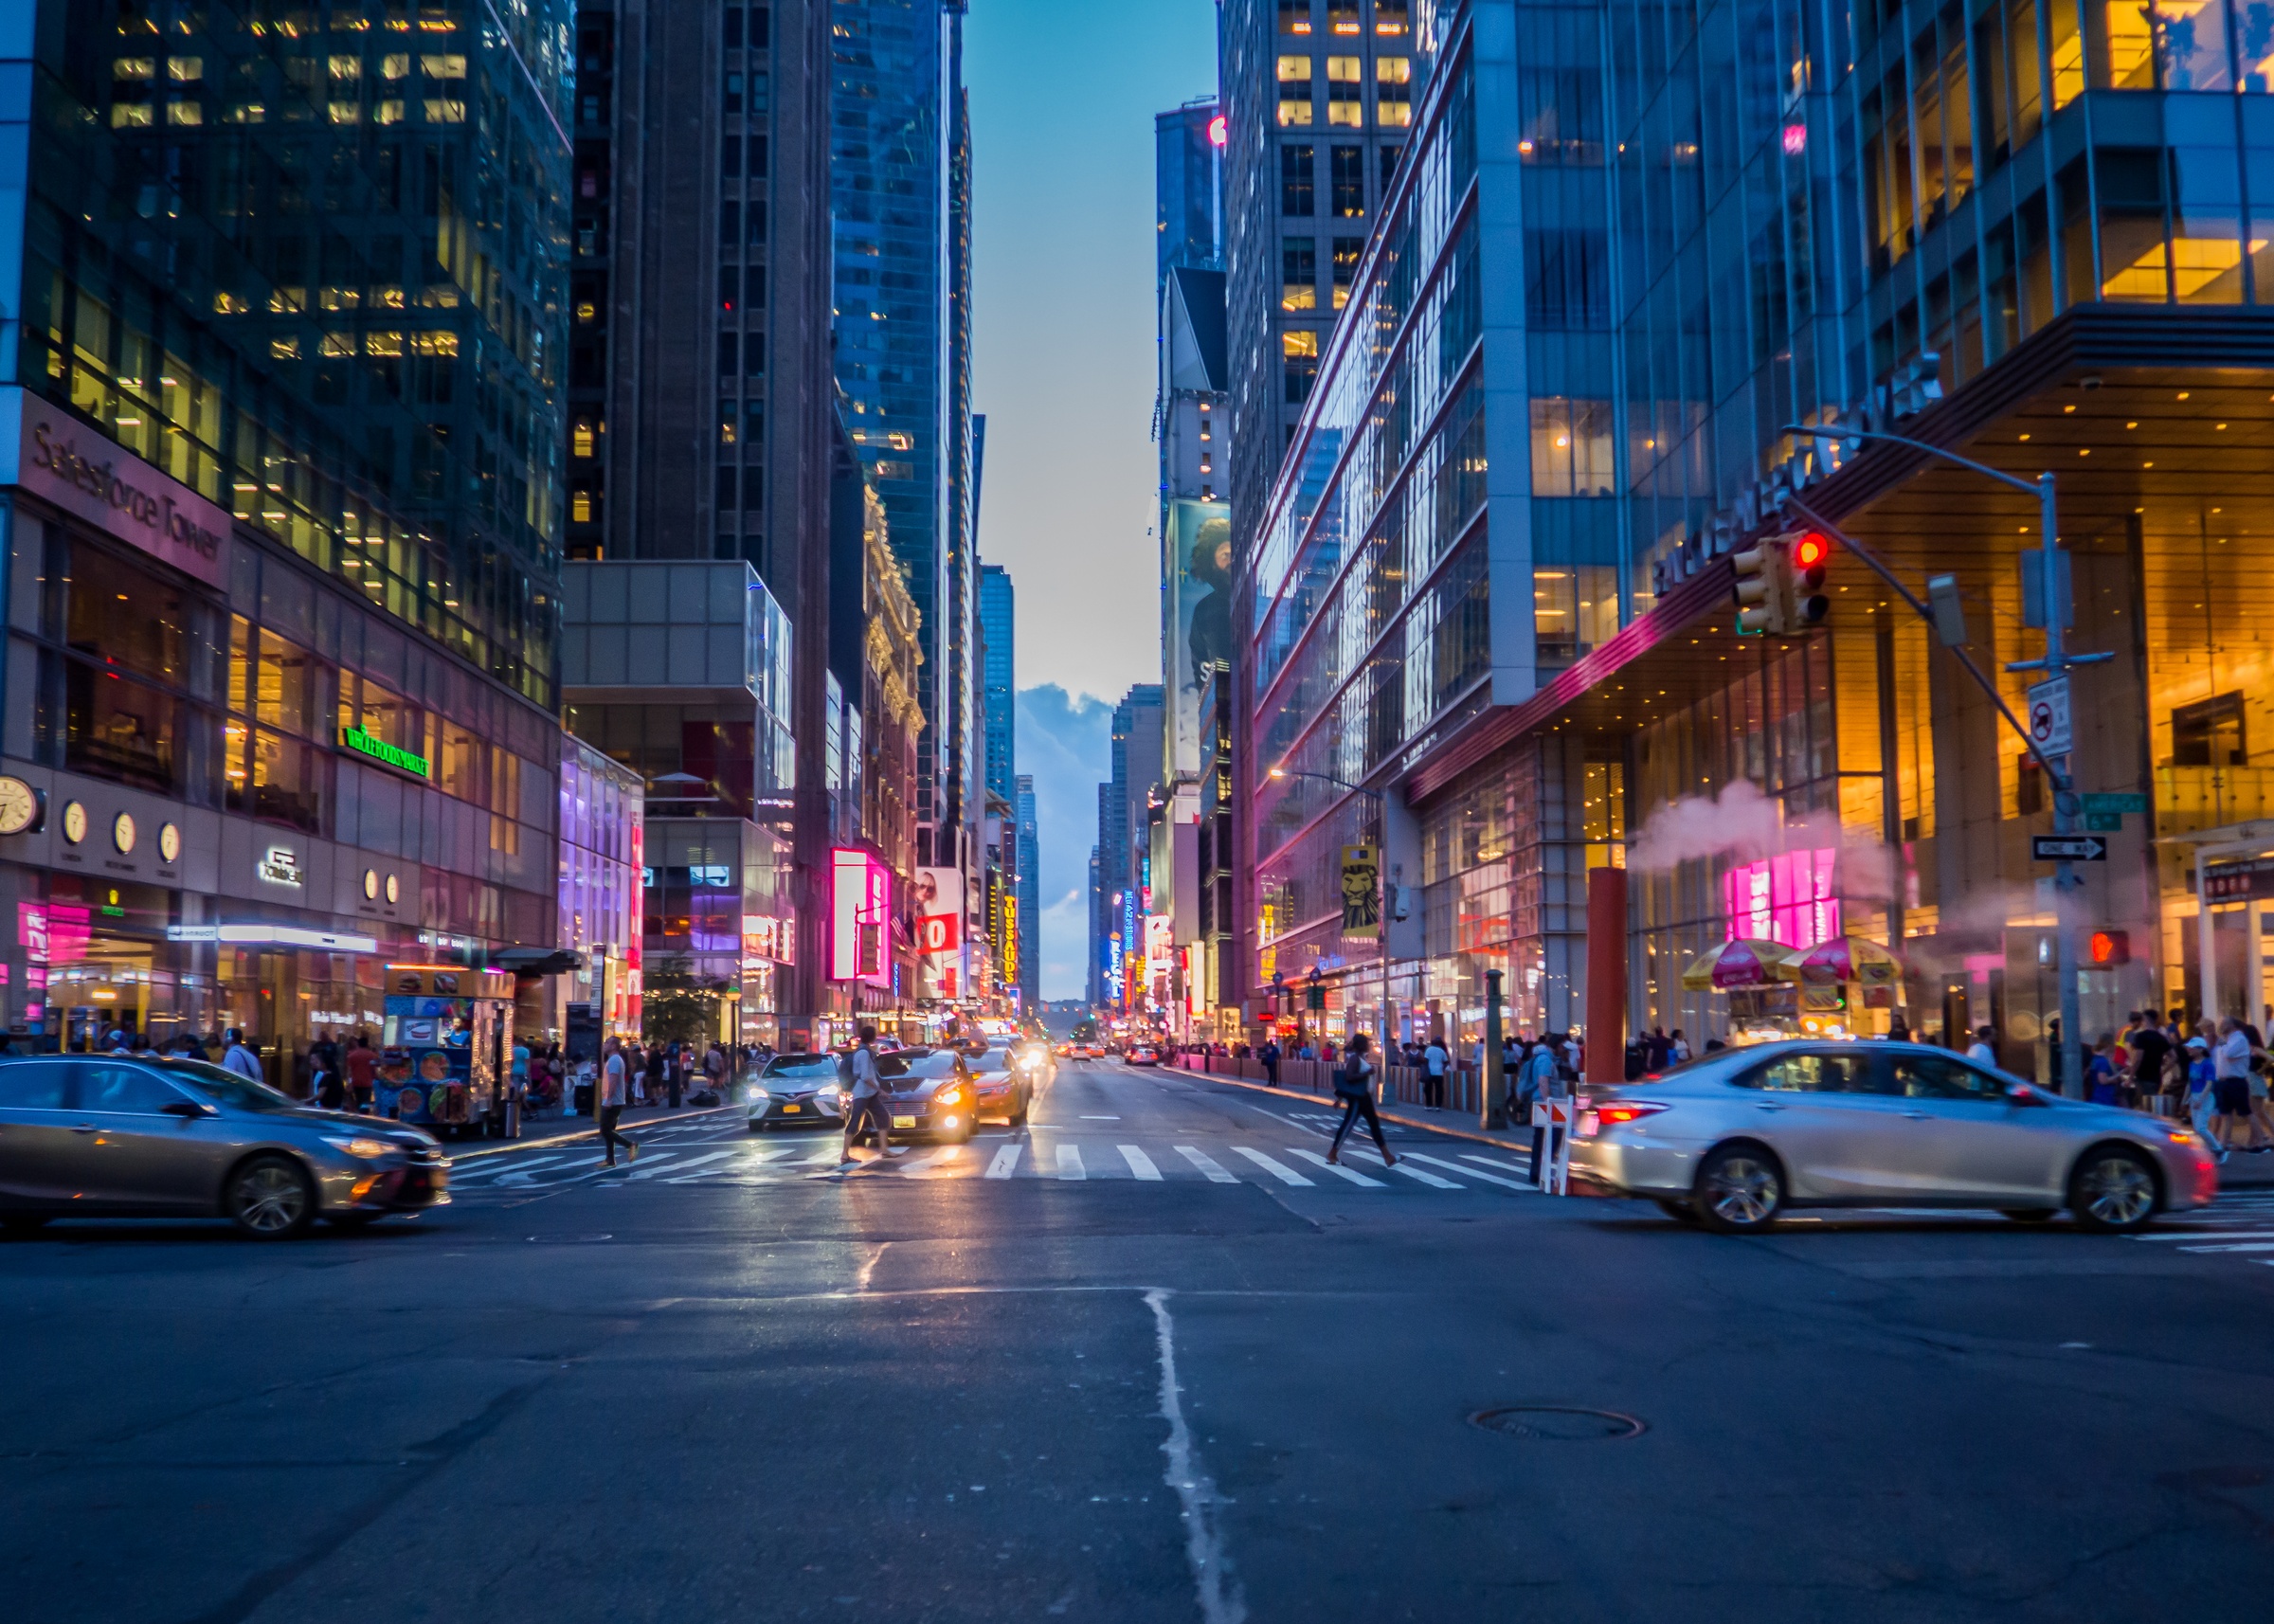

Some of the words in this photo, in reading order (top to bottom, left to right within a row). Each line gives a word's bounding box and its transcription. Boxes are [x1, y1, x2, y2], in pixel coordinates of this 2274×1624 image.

[32, 423, 158, 530] Salesforce
[161, 495, 223, 562] Tower
[2042, 842, 2064, 854] ONE
[2075, 843, 2095, 854] WAY
[1003, 894, 1017, 983] TUSSAUDS
[1110, 940, 1122, 999] REGAL
